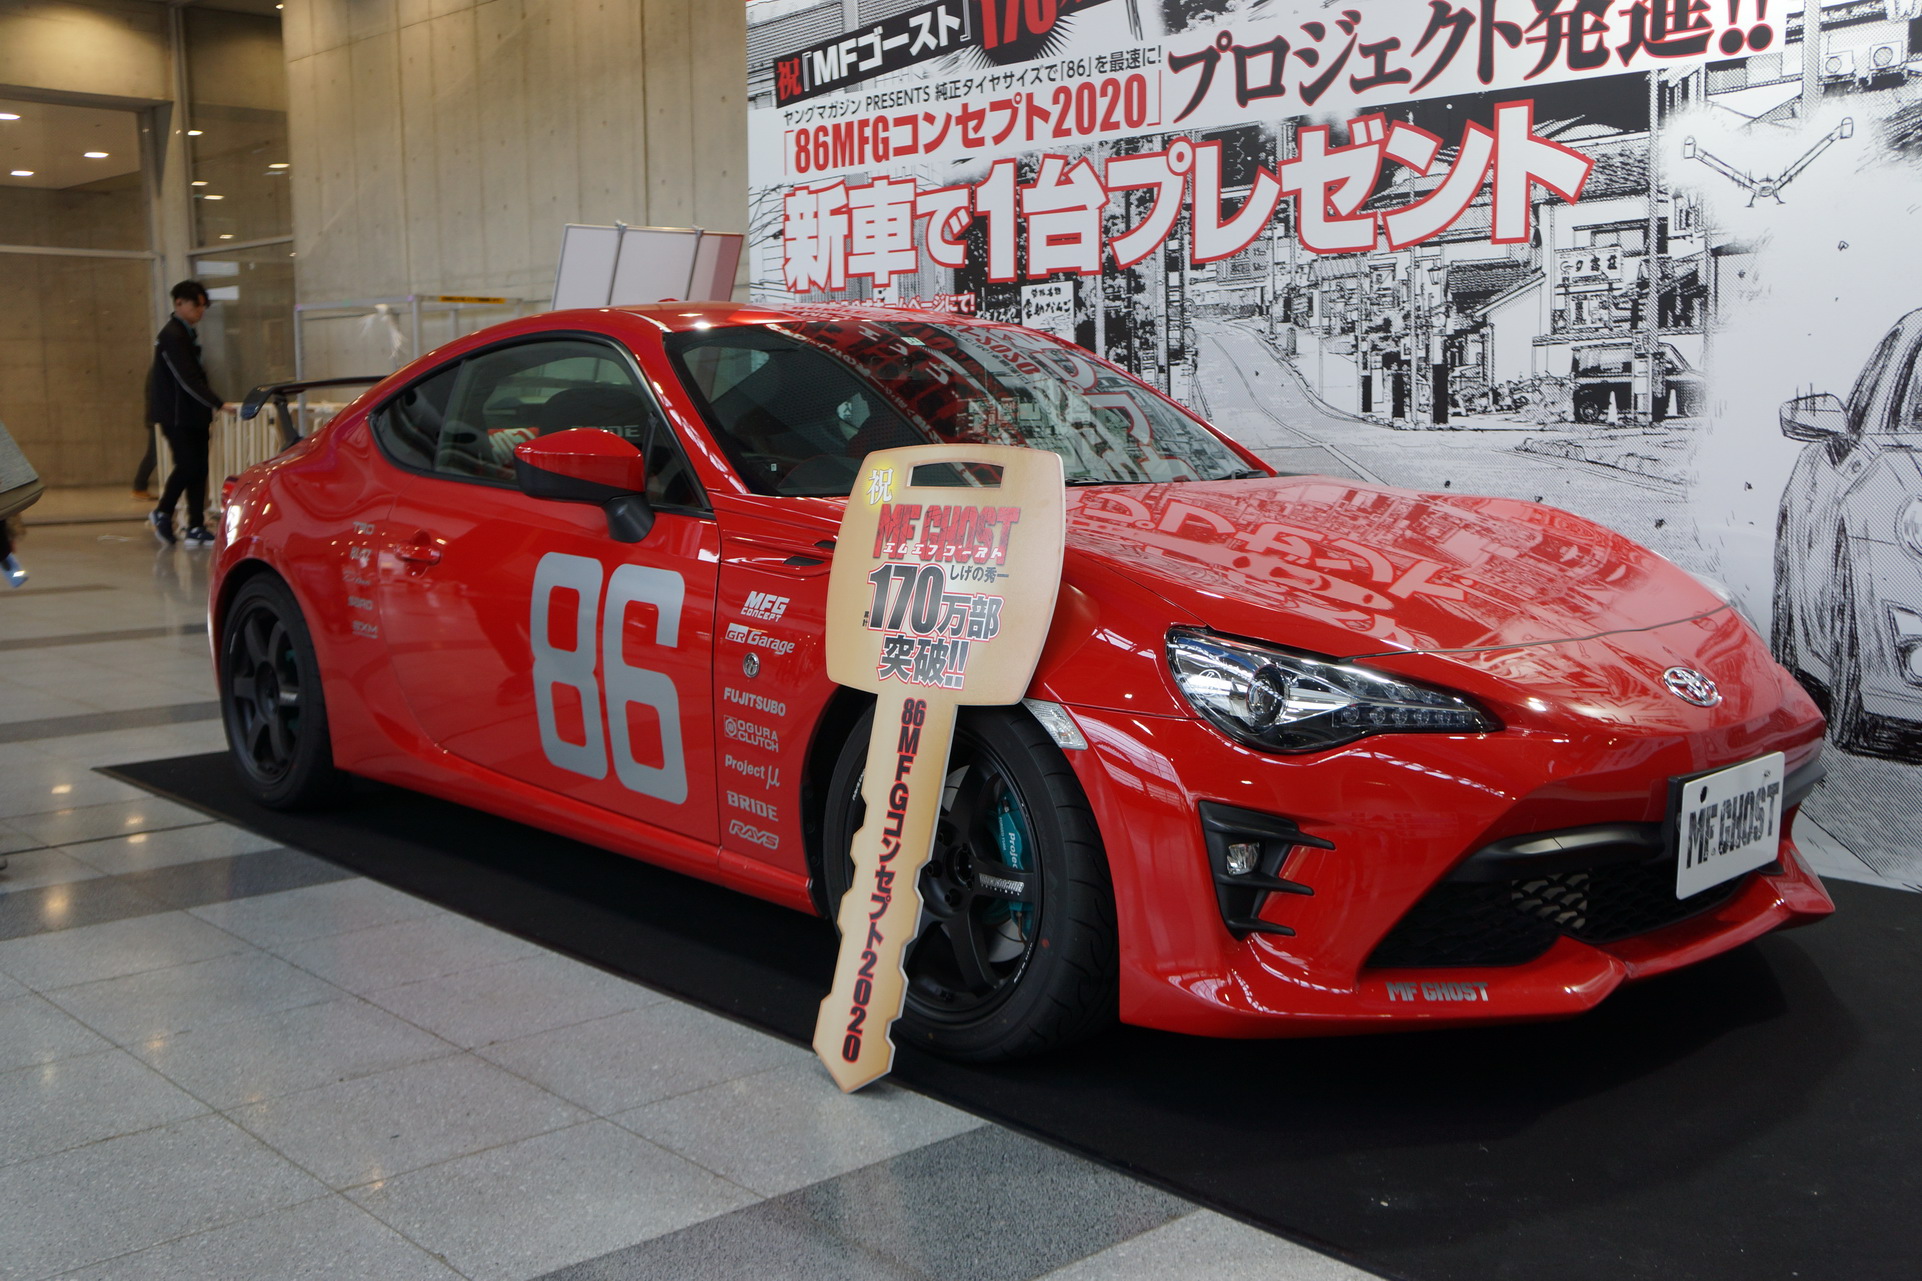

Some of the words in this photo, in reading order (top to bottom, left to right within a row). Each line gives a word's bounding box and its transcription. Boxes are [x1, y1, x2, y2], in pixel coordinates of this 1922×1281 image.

[784, 99, 862, 126] ヤングマガジン
[865, 85, 931, 112] PRESENTS
[783, 99, 1595, 293] 新車で1台プレゼント
[868, 468, 894, 505] 祝
[873, 504, 922, 559] MF
[920, 505, 1020, 565] GHOST
[949, 564, 1009, 583] しげの秀一
[740, 607, 782, 623] CONCEPT
[744, 591, 790, 615] MFG
[726, 629, 747, 643] GR
[747, 631, 796, 655] Garage
[530, 551, 688, 805] 86
[724, 687, 786, 717] FUJITSUBO
[737, 720, 778, 741] OGURA
[738, 730, 779, 752] CLUTCH
[726, 790, 779, 822] BRIDE
[729, 819, 779, 850] RAYS
[1686, 803, 1718, 869] MF
[1718, 781, 1780, 856] GHOST
[1385, 981, 1418, 1001] MF
[1421, 981, 1489, 1002] GHOST
